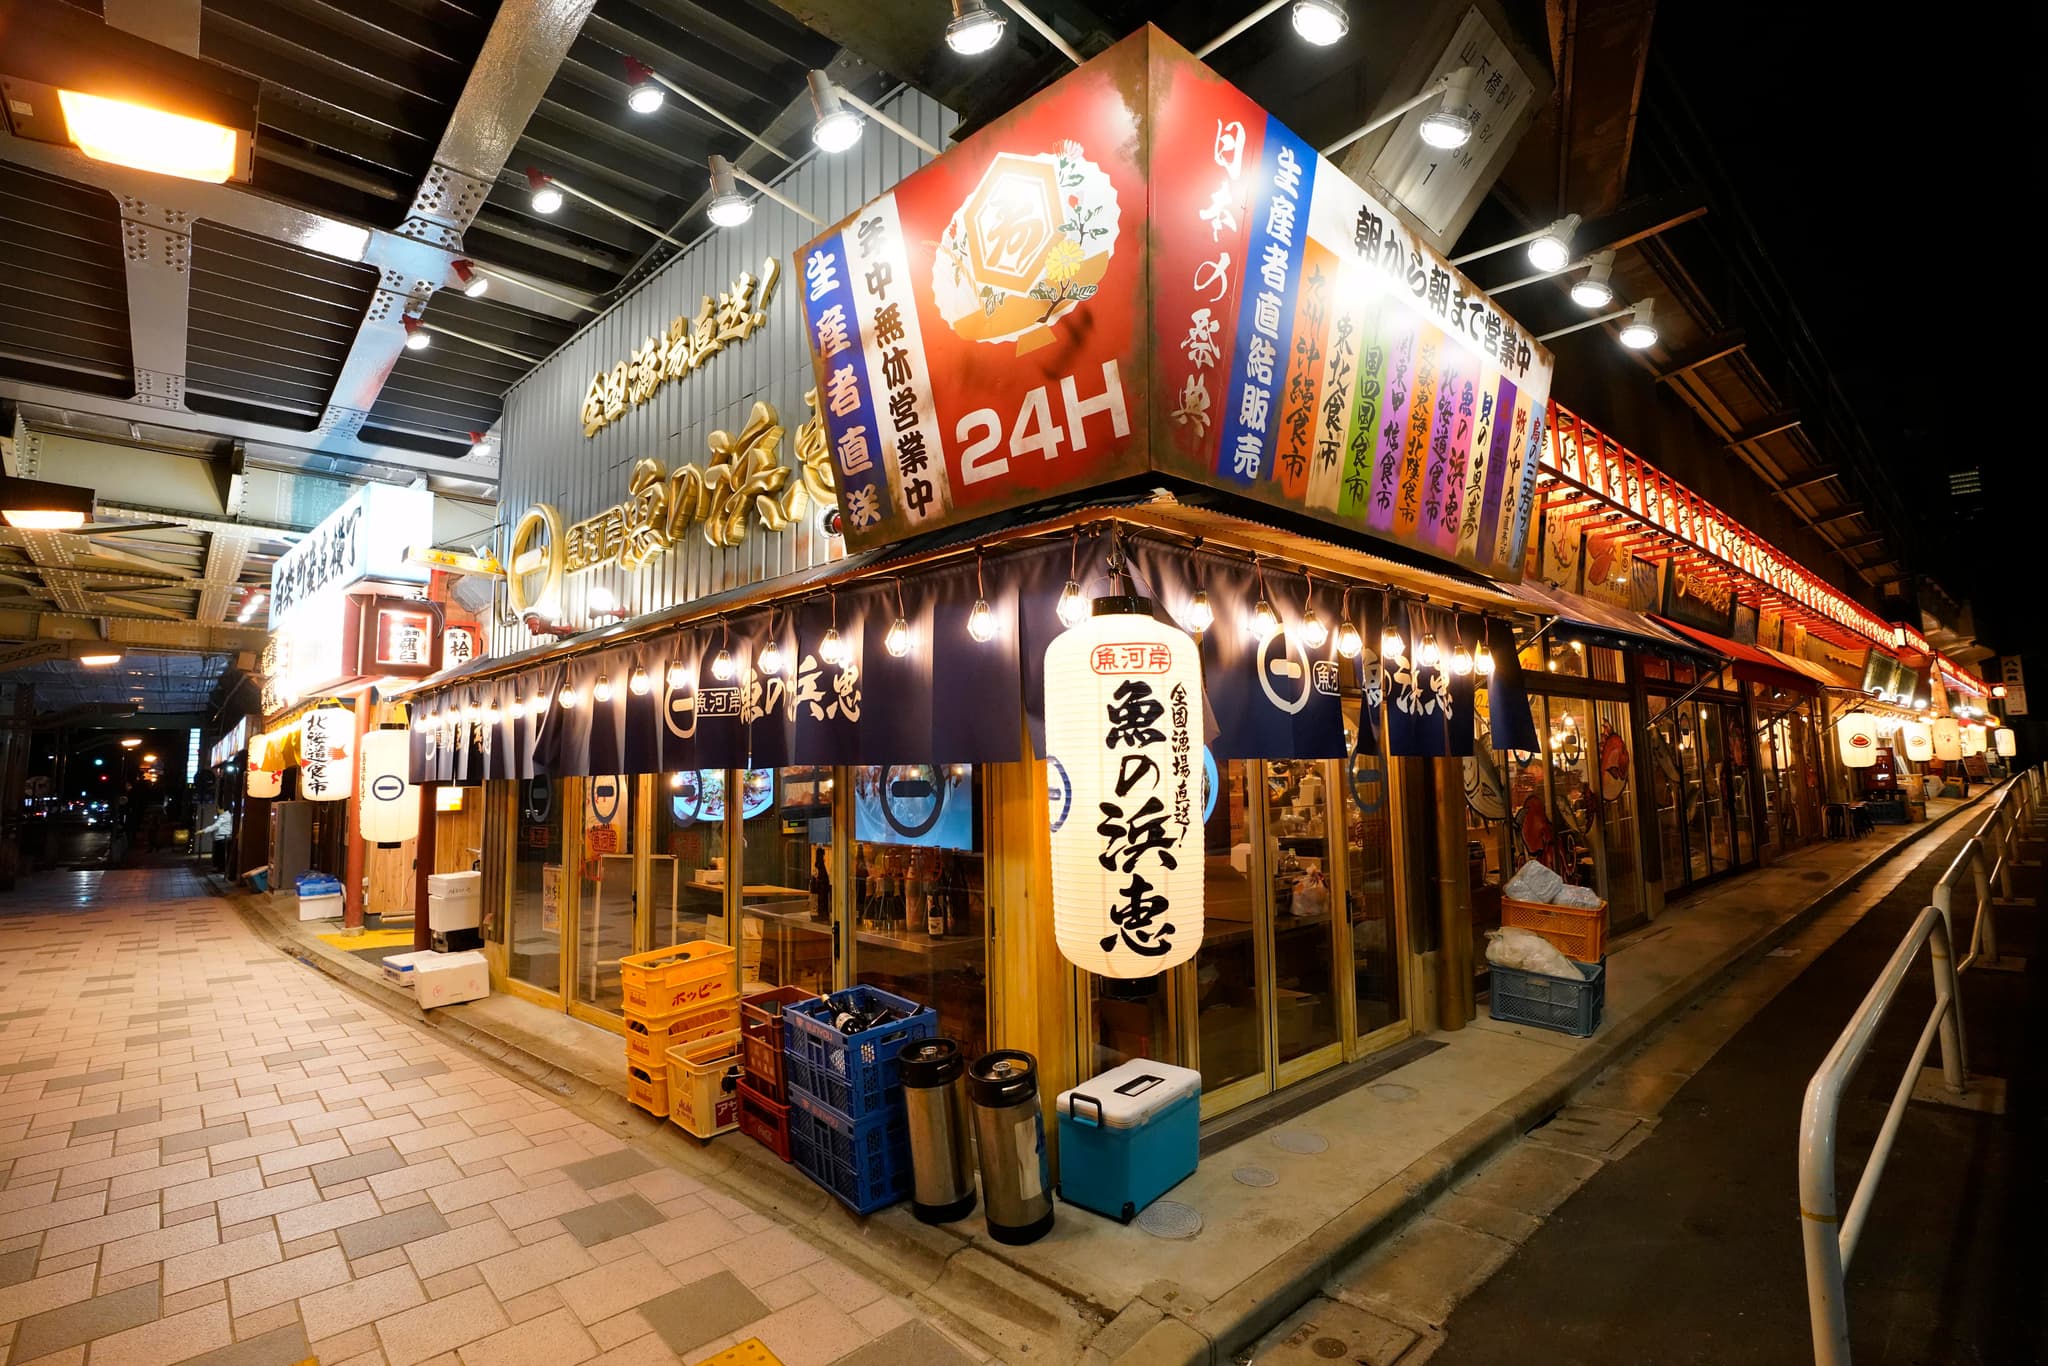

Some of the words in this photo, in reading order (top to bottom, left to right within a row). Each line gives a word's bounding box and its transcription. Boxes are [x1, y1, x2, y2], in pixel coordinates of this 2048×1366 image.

[857, 216, 934, 517] 年中無休営業中
[1233, 146, 1302, 479] 生産者直結販売
[1354, 204, 1532, 378] 朝から朝まで営業中
[806, 249, 881, 532] 生産者直送
[955, 358, 1131, 487] 24H
[1318, 311, 1353, 474] 東北食市
[1095, 646, 1170, 670] 魚河岸
[306, 714, 329, 796] 北海道食市
[1097, 680, 1178, 957] 魚の浜恵
[671, 981, 722, 1007] ホッピー
